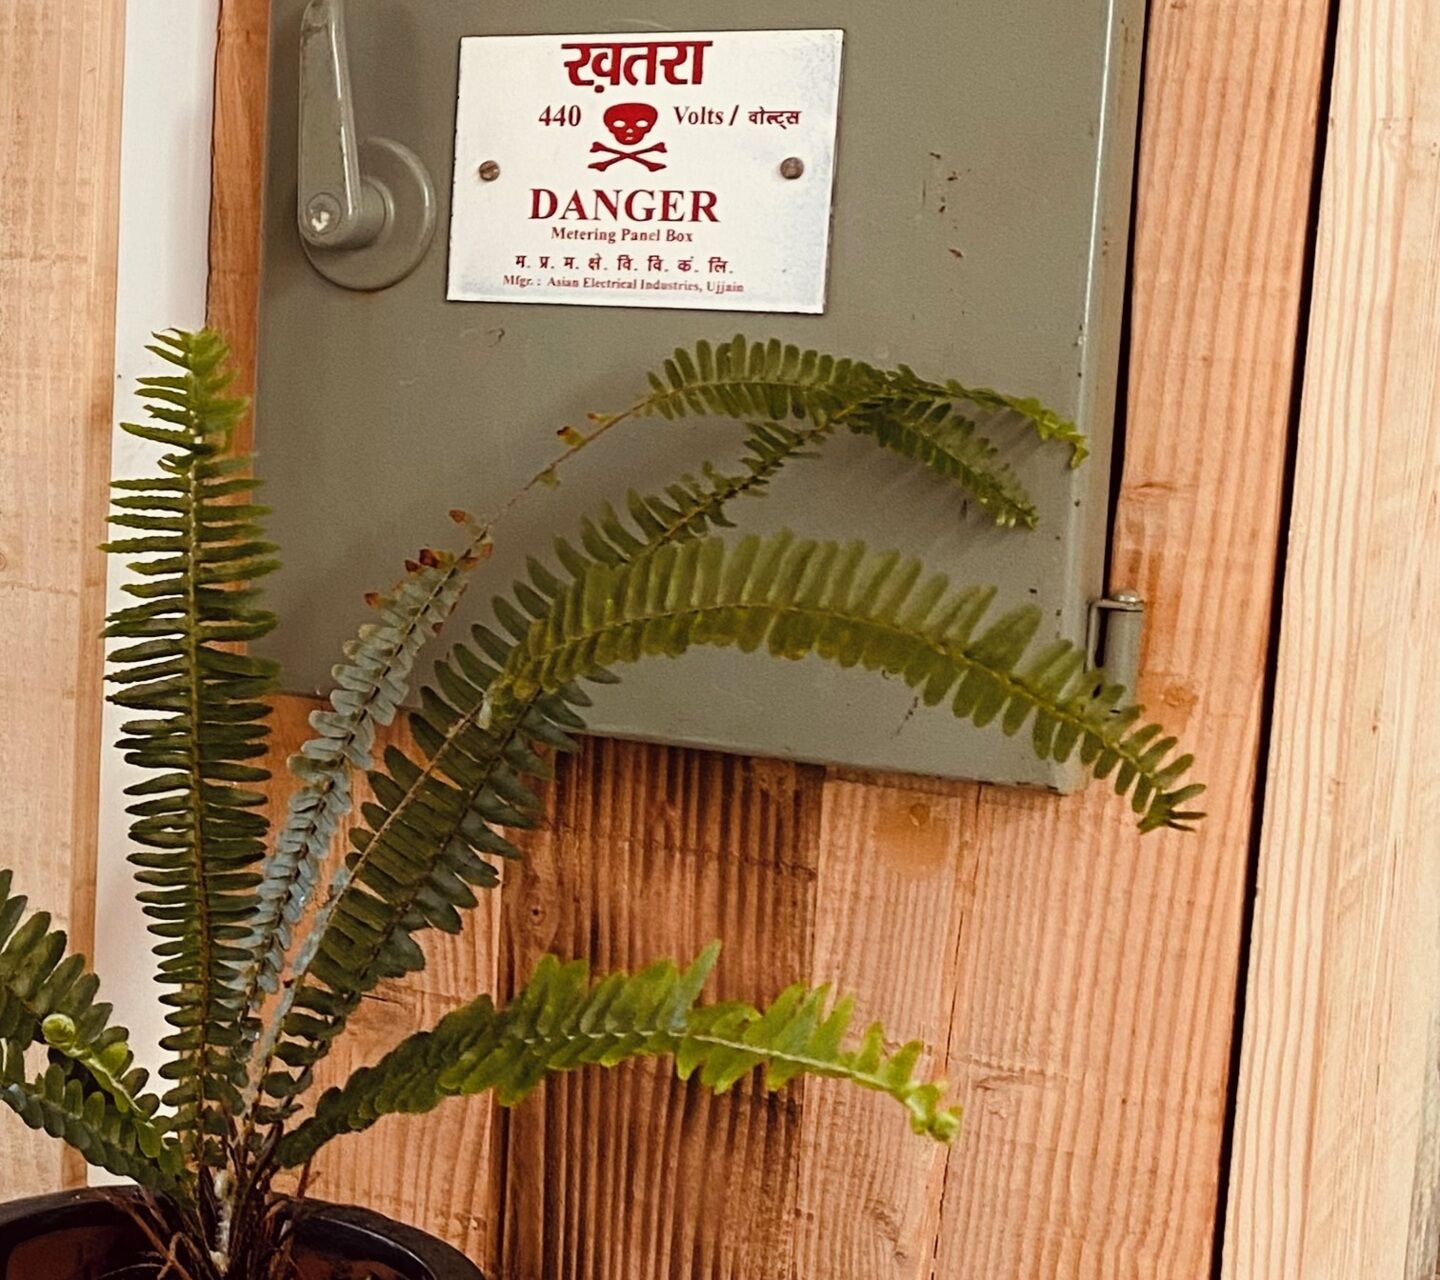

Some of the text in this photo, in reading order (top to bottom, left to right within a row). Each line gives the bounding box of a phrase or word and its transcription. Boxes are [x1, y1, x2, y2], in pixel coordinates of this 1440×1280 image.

[538, 104, 582, 127] 440
[528, 188, 721, 222] DANGER
[550, 226, 694, 244] Metering Panel Box
[547, 276, 580, 288] Asian
[582, 277, 637, 289] Electrical
[640, 279, 704, 293] Industries,
